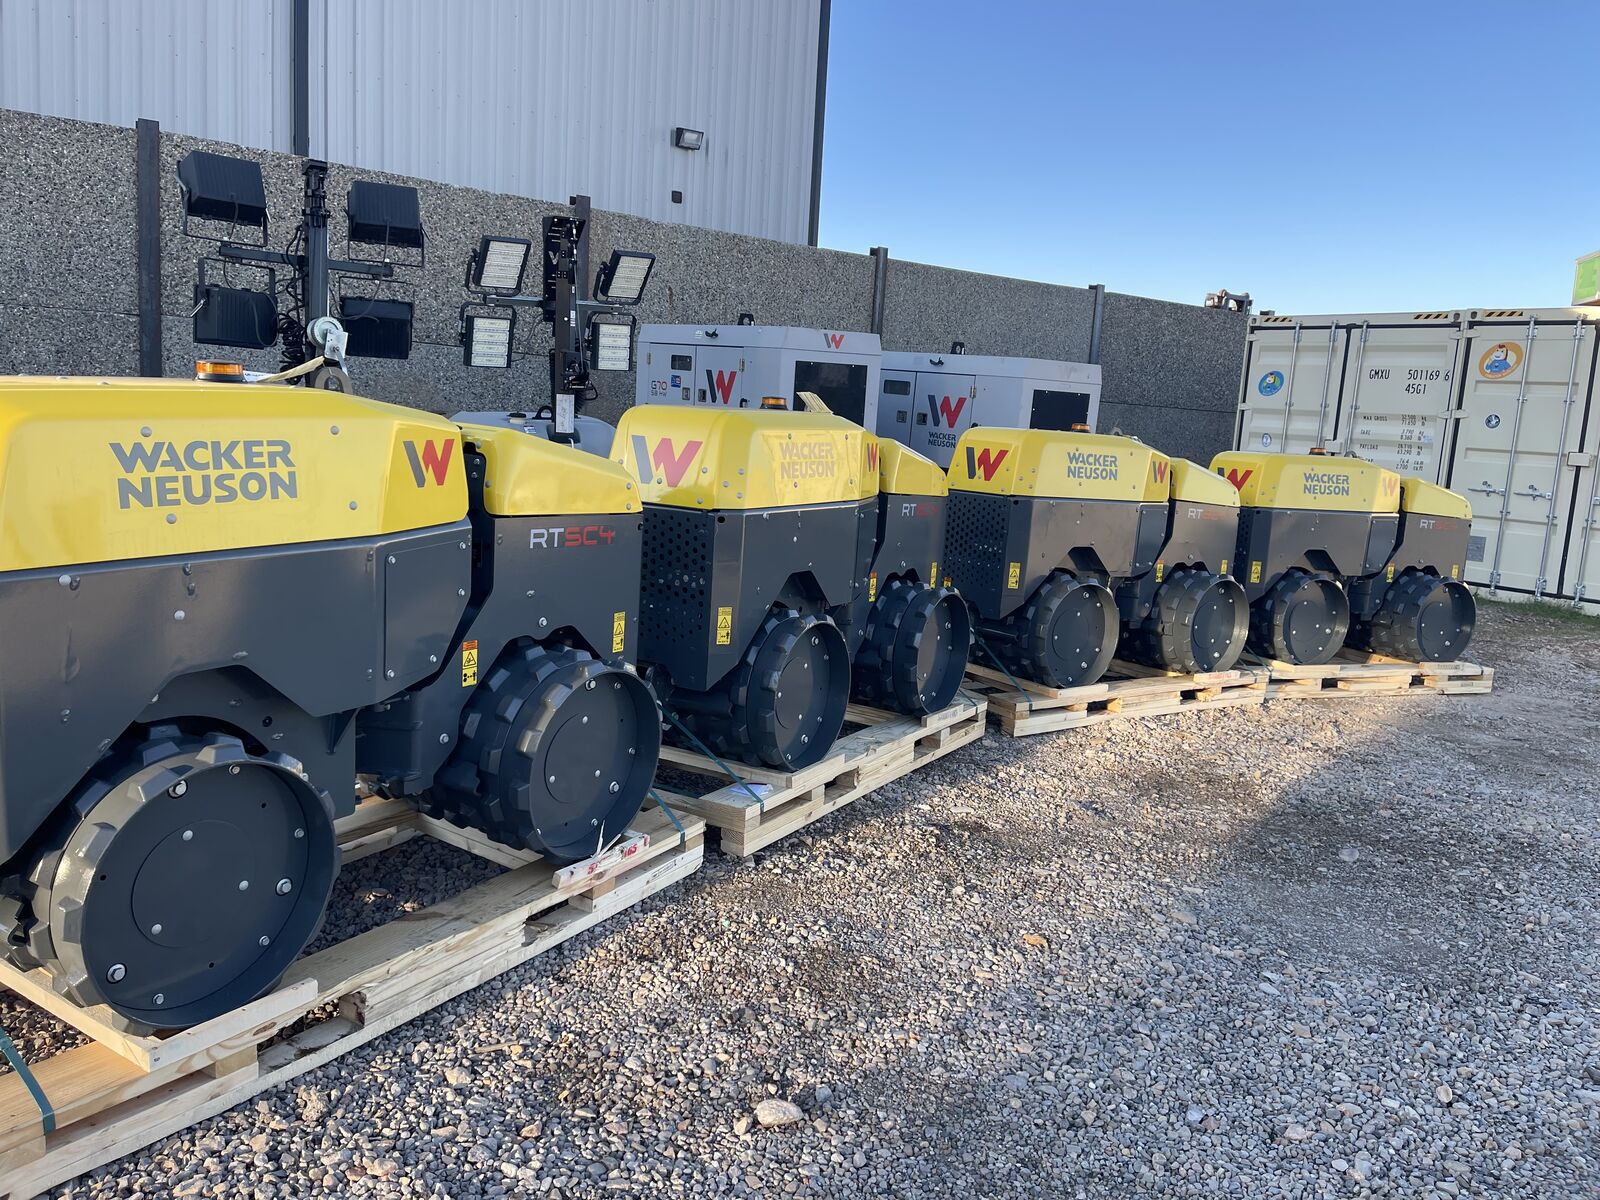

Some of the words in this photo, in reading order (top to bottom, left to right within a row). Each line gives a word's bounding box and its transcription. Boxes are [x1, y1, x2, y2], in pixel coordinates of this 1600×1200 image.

[1369, 369, 1390, 380] GMXU
[1407, 369, 1440, 381] 501169
[651, 380, 667, 390] G70
[1405, 383, 1426, 395] 45G1
[928, 431, 956, 441] WACKER
[780, 442, 833, 460] WACKER
[928, 439, 956, 449] NEUSON
[109, 440, 296, 474] WACKER
[1067, 452, 1118, 468] WACKER
[781, 461, 835, 480] NEUSON
[1067, 466, 1118, 481] NEUSON
[1303, 473, 1350, 486] WACKER
[117, 471, 298, 510] NEUSON
[1303, 484, 1350, 497] NEUSON
[529, 525, 616, 549] RTSC4
